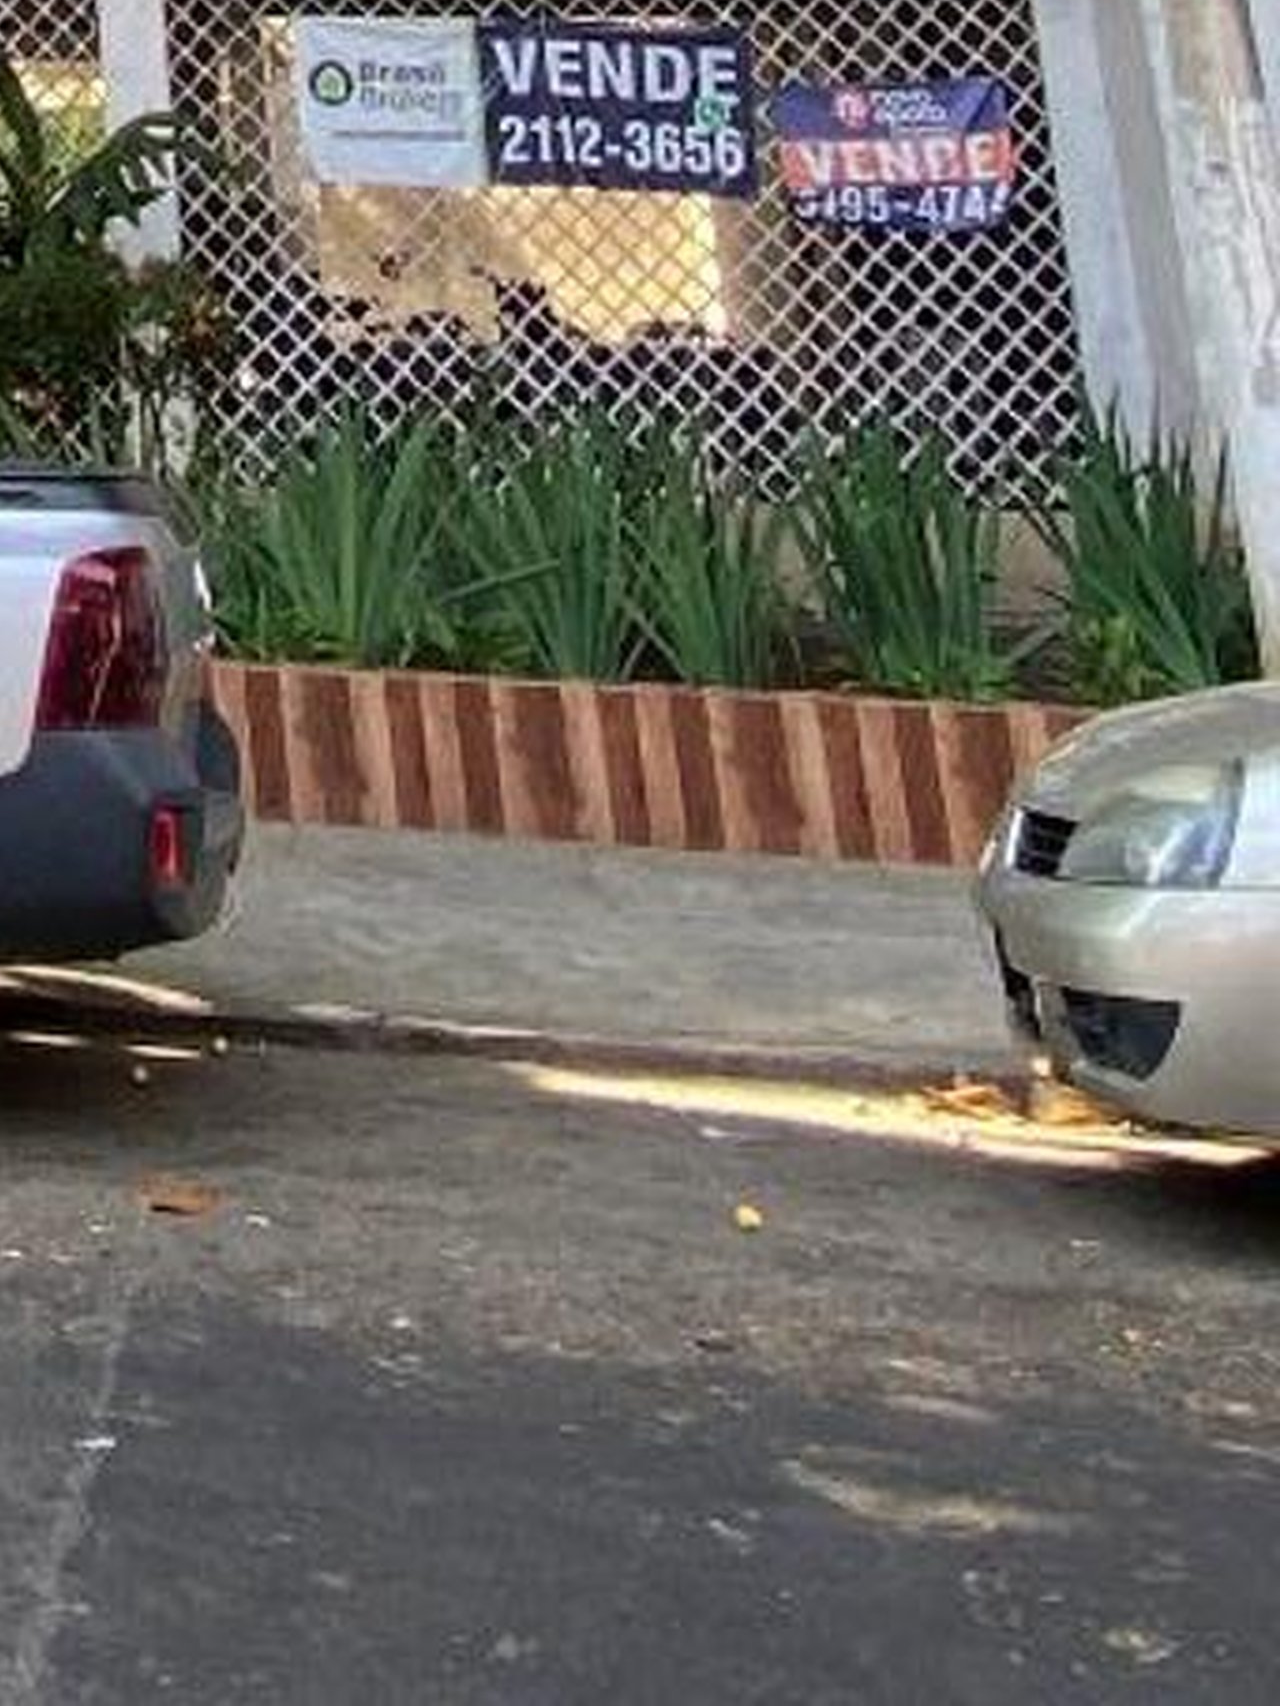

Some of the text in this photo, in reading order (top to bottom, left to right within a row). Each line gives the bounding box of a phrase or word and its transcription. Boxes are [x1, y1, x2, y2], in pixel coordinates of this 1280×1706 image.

[493, 39, 740, 106] VENDE
[499, 114, 745, 177] 2112-3656
[797, 133, 1005, 185] VENDE
